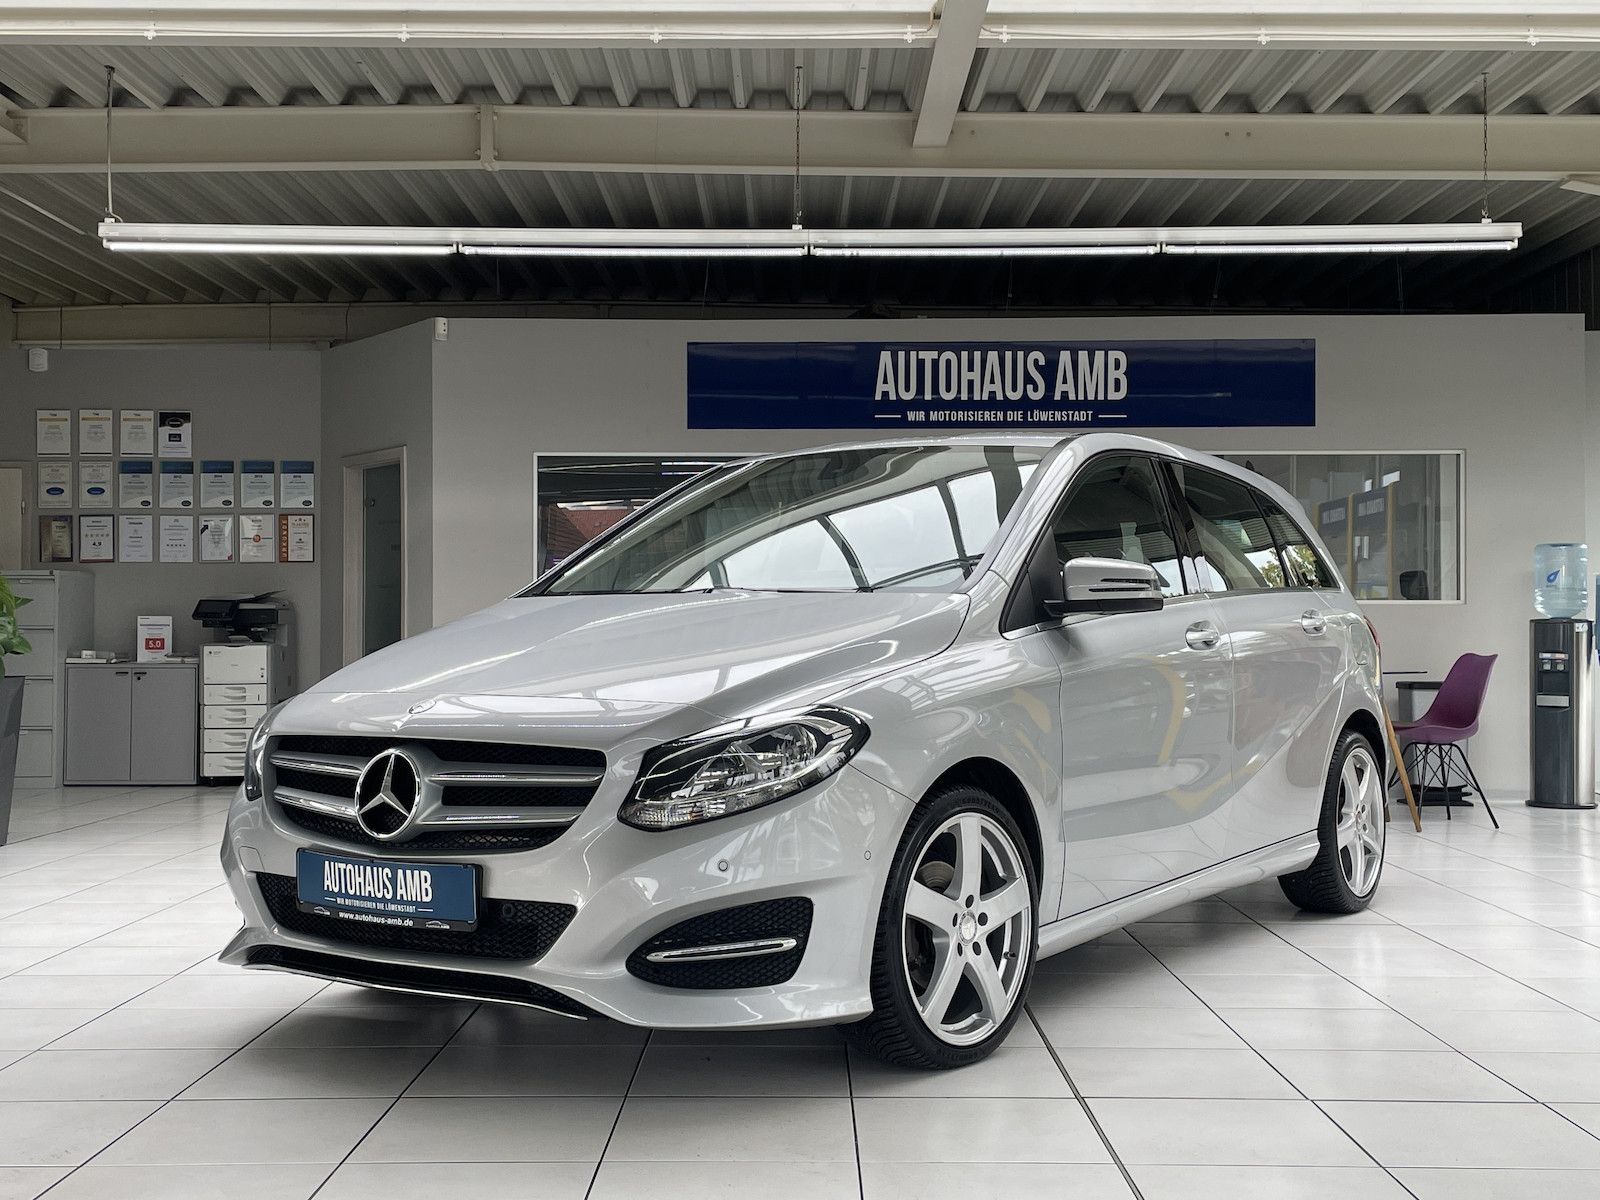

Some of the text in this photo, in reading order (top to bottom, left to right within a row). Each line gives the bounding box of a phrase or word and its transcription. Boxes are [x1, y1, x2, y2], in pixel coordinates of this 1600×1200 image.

[875, 350, 1128, 401] AUTOHAUS AMB
[907, 408, 1093, 422] WIR MOTORISIEREN DIE LÖWENSTADT
[324, 860, 433, 903] AUTOHAUS AMB
[336, 897, 345, 905] WIR
[345, 899, 377, 908] MOTORISIEREN
[385, 902, 416, 913] LÖWENSTADT
[338, 910, 414, 927] www.autohaus-amb.de
